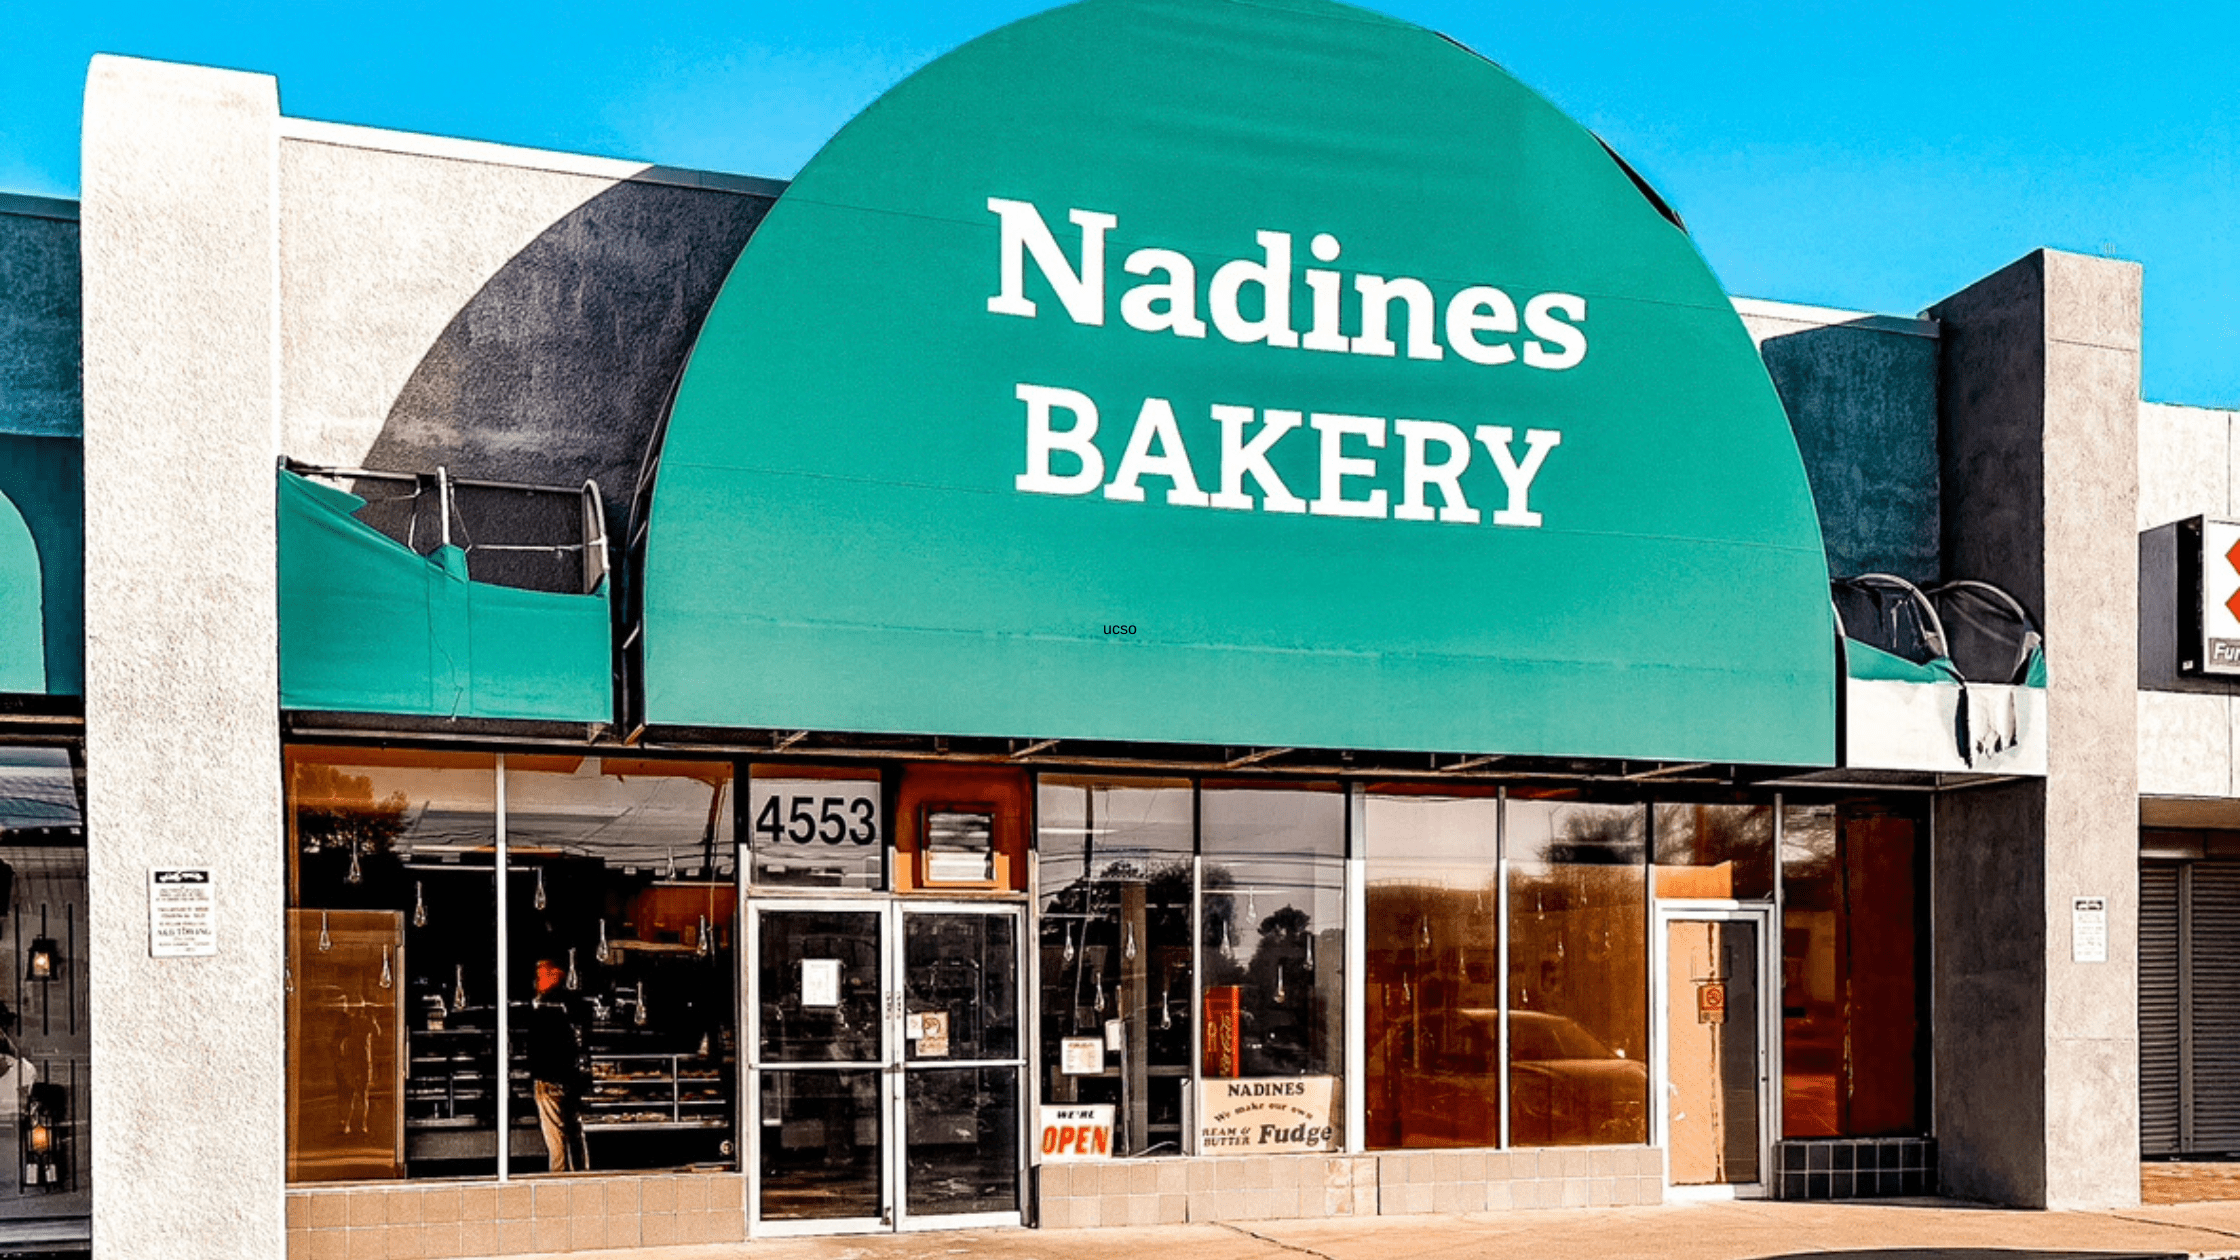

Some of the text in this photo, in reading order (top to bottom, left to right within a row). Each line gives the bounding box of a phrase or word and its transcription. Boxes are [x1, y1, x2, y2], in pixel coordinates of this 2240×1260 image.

[987, 196, 1588, 371] Nadines
[1015, 383, 1561, 528] BAKERY
[756, 795, 876, 846] 4553
[1228, 1081, 1305, 1097] NADINES
[1214, 1101, 1313, 1122] We make our own
[1042, 1124, 1109, 1155] OPEN
[1203, 1135, 1251, 1147] BUTTER
[1258, 1122, 1333, 1147] Fudge
